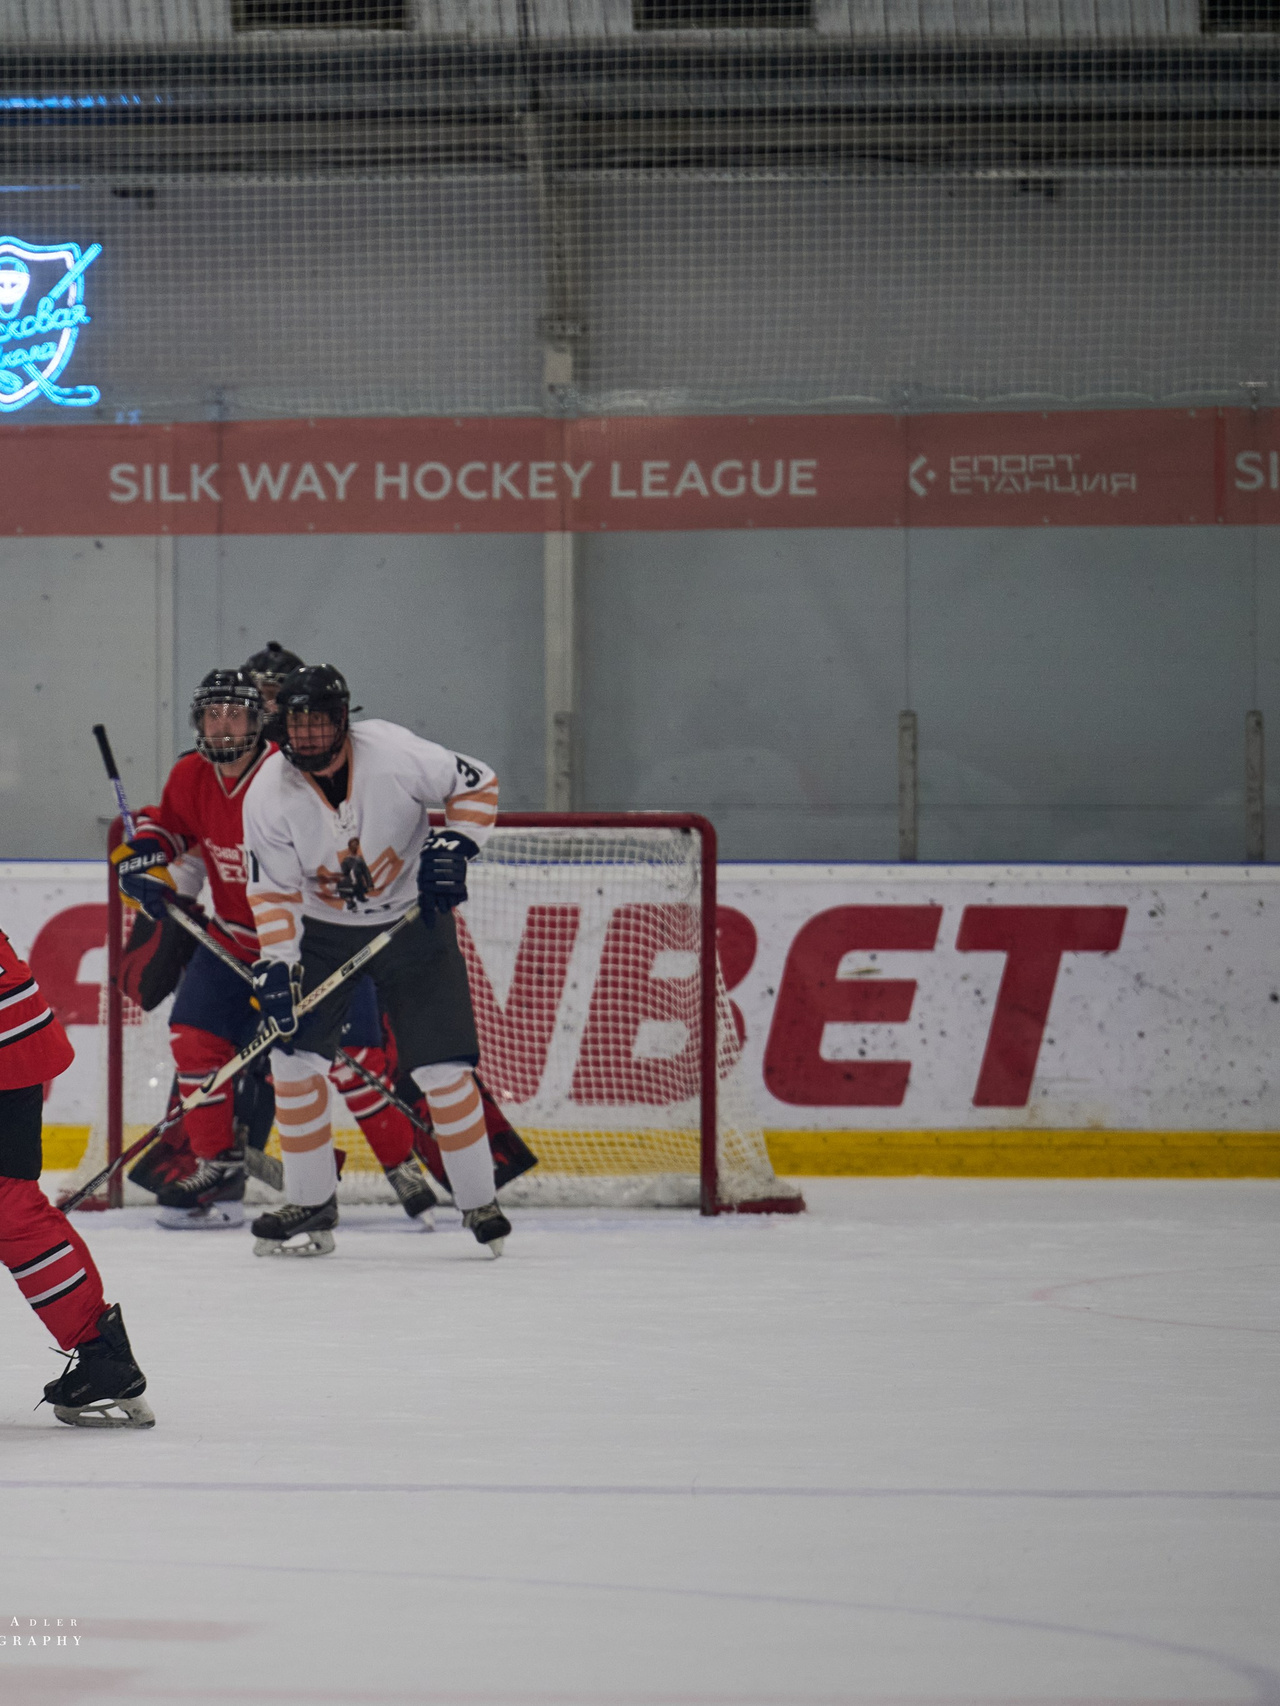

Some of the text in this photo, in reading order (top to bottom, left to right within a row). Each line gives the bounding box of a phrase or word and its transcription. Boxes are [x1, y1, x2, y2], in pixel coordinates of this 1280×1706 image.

[949, 454, 1081, 473] СПОРТ
[109, 459, 818, 502] SILK WAY HOCKEY LEAGUE
[949, 474, 1137, 497] СТАНЦИЯ
[455, 755, 483, 788] 3
